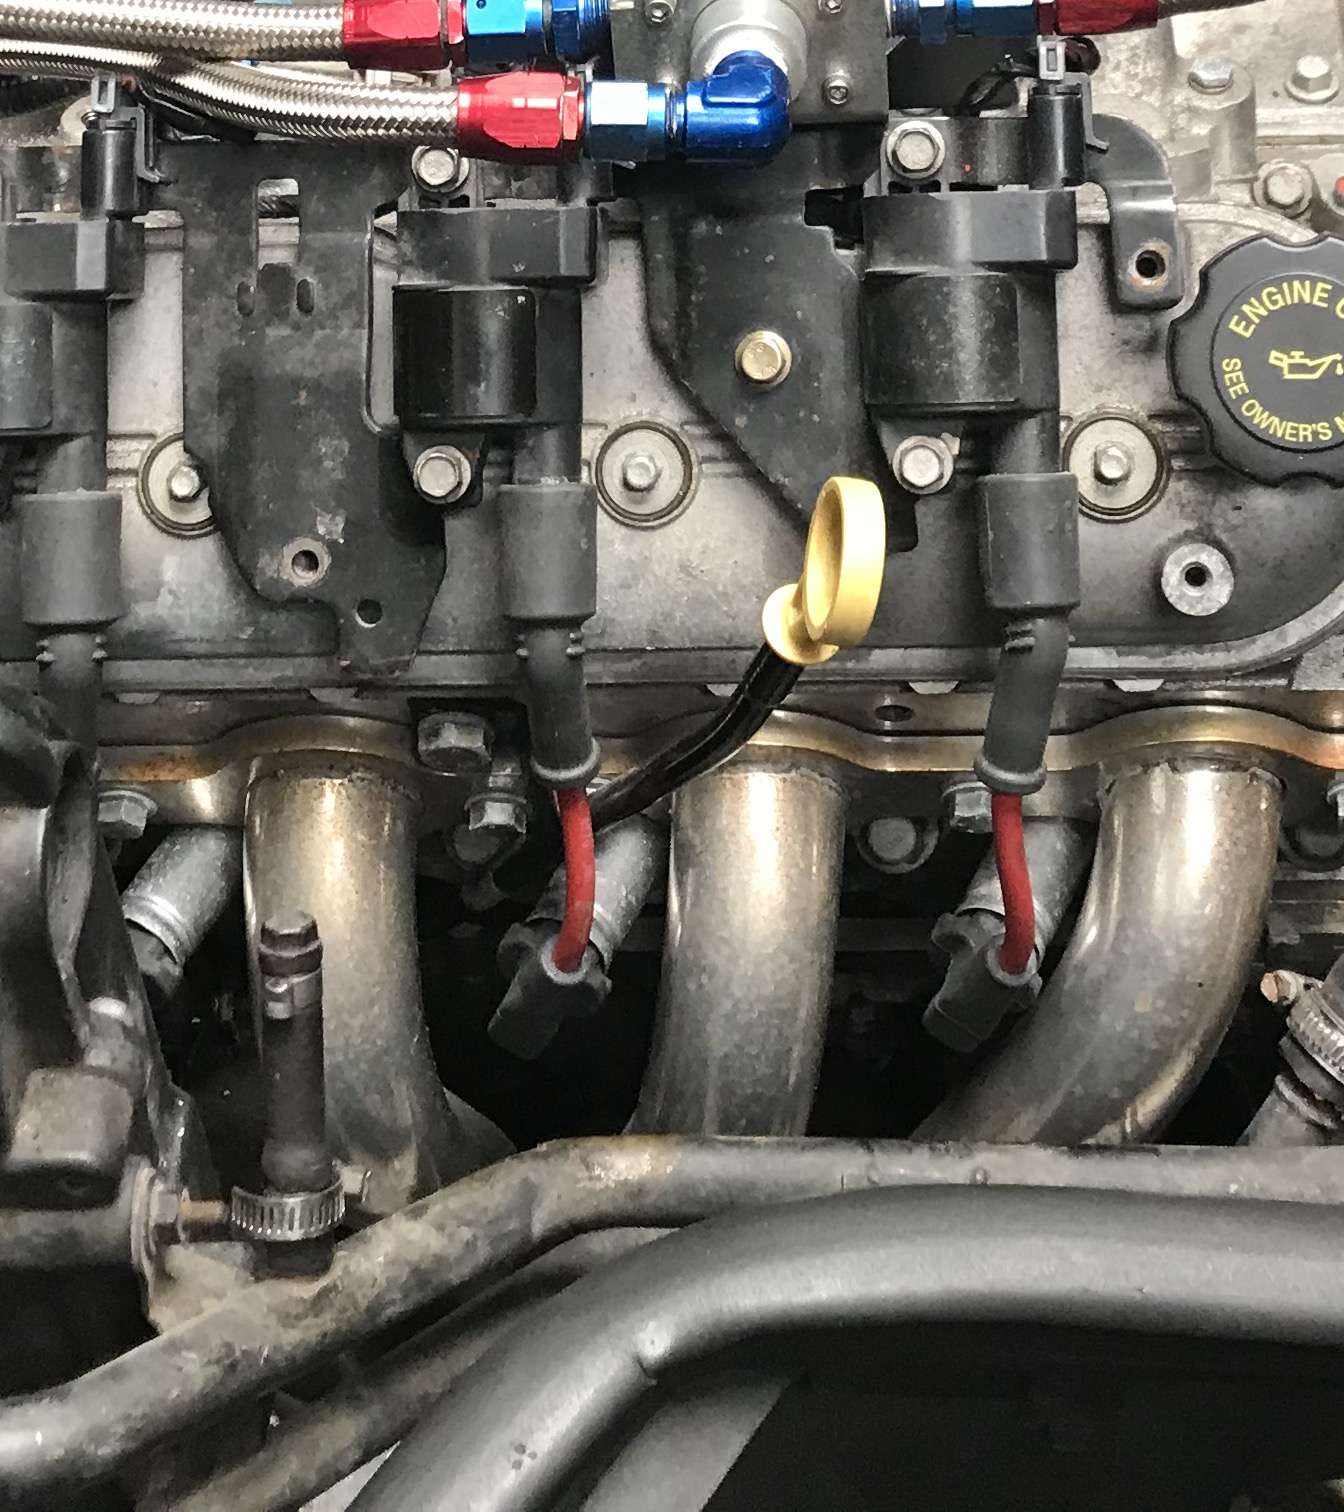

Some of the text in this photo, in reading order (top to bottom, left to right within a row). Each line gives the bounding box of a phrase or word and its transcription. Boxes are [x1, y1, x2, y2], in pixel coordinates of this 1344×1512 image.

[1228, 280, 1333, 338] ENGINE
[1221, 357, 1250, 400] SEE
[1241, 399, 1333, 443] OWNER'S
